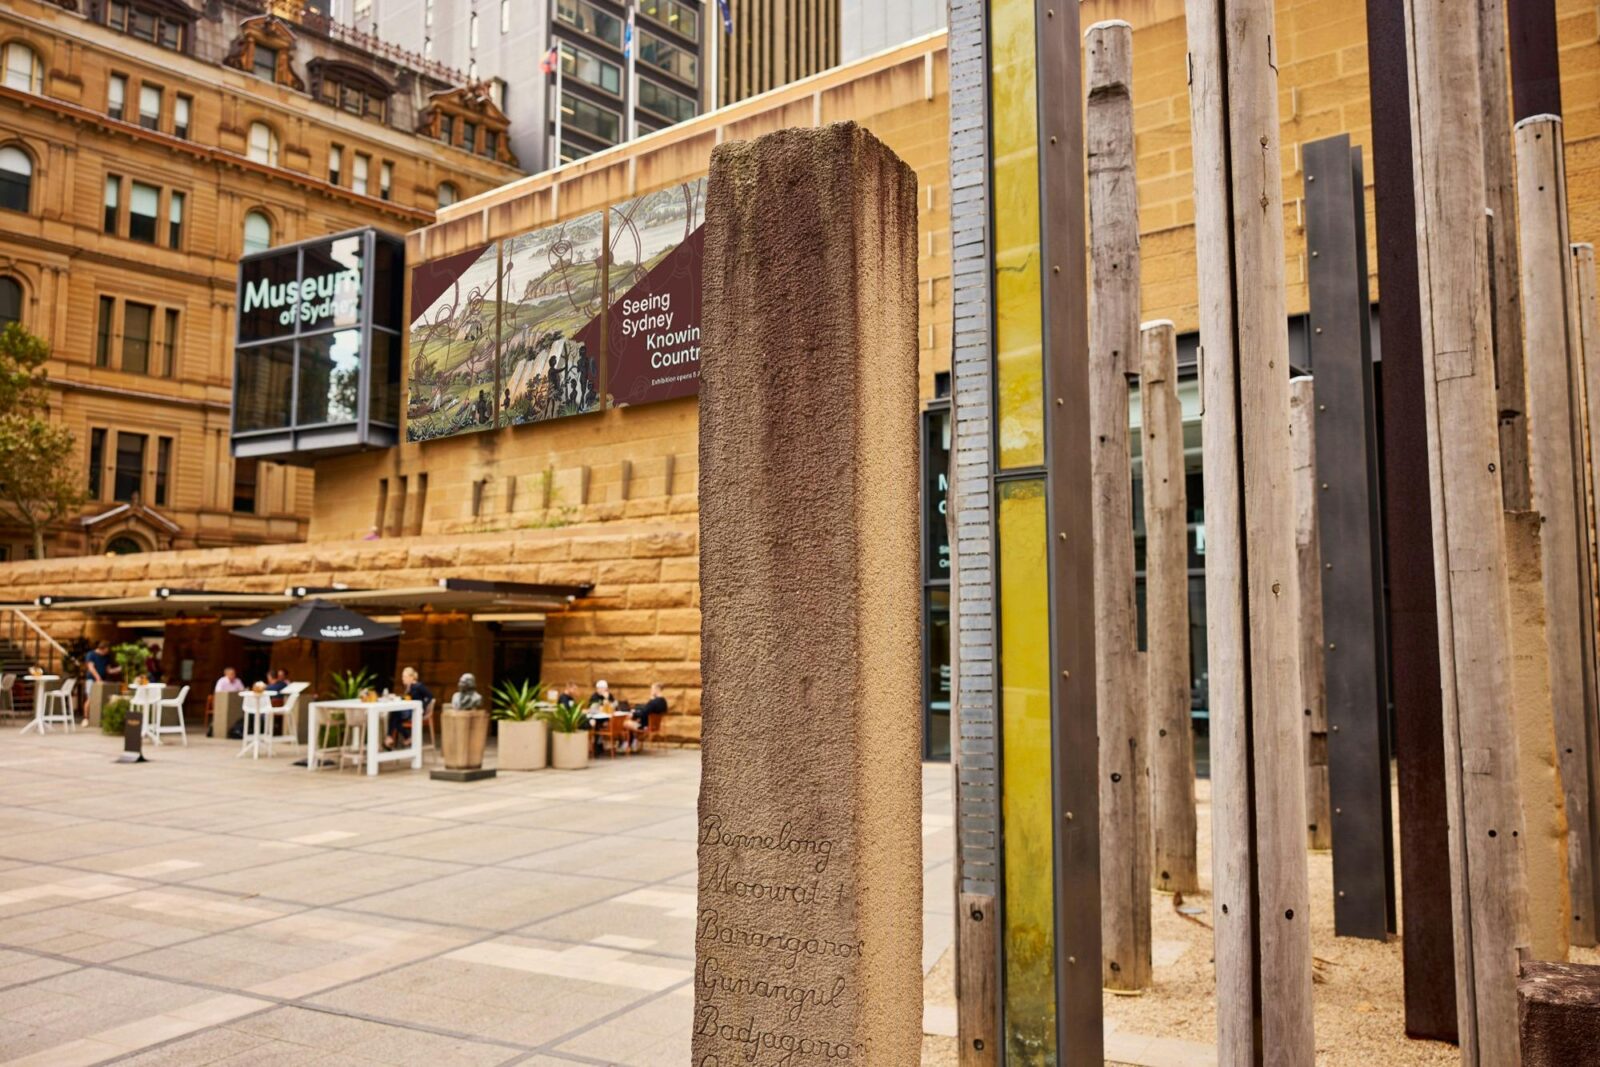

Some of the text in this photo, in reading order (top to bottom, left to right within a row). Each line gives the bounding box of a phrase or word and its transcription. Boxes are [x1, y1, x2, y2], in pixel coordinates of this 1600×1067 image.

[243, 270, 360, 313] Museum
[622, 293, 670, 316] Seeing
[280, 303, 299, 325] of
[622, 312, 674, 338] Sydney
[700, 814, 832, 873] Bennelong
